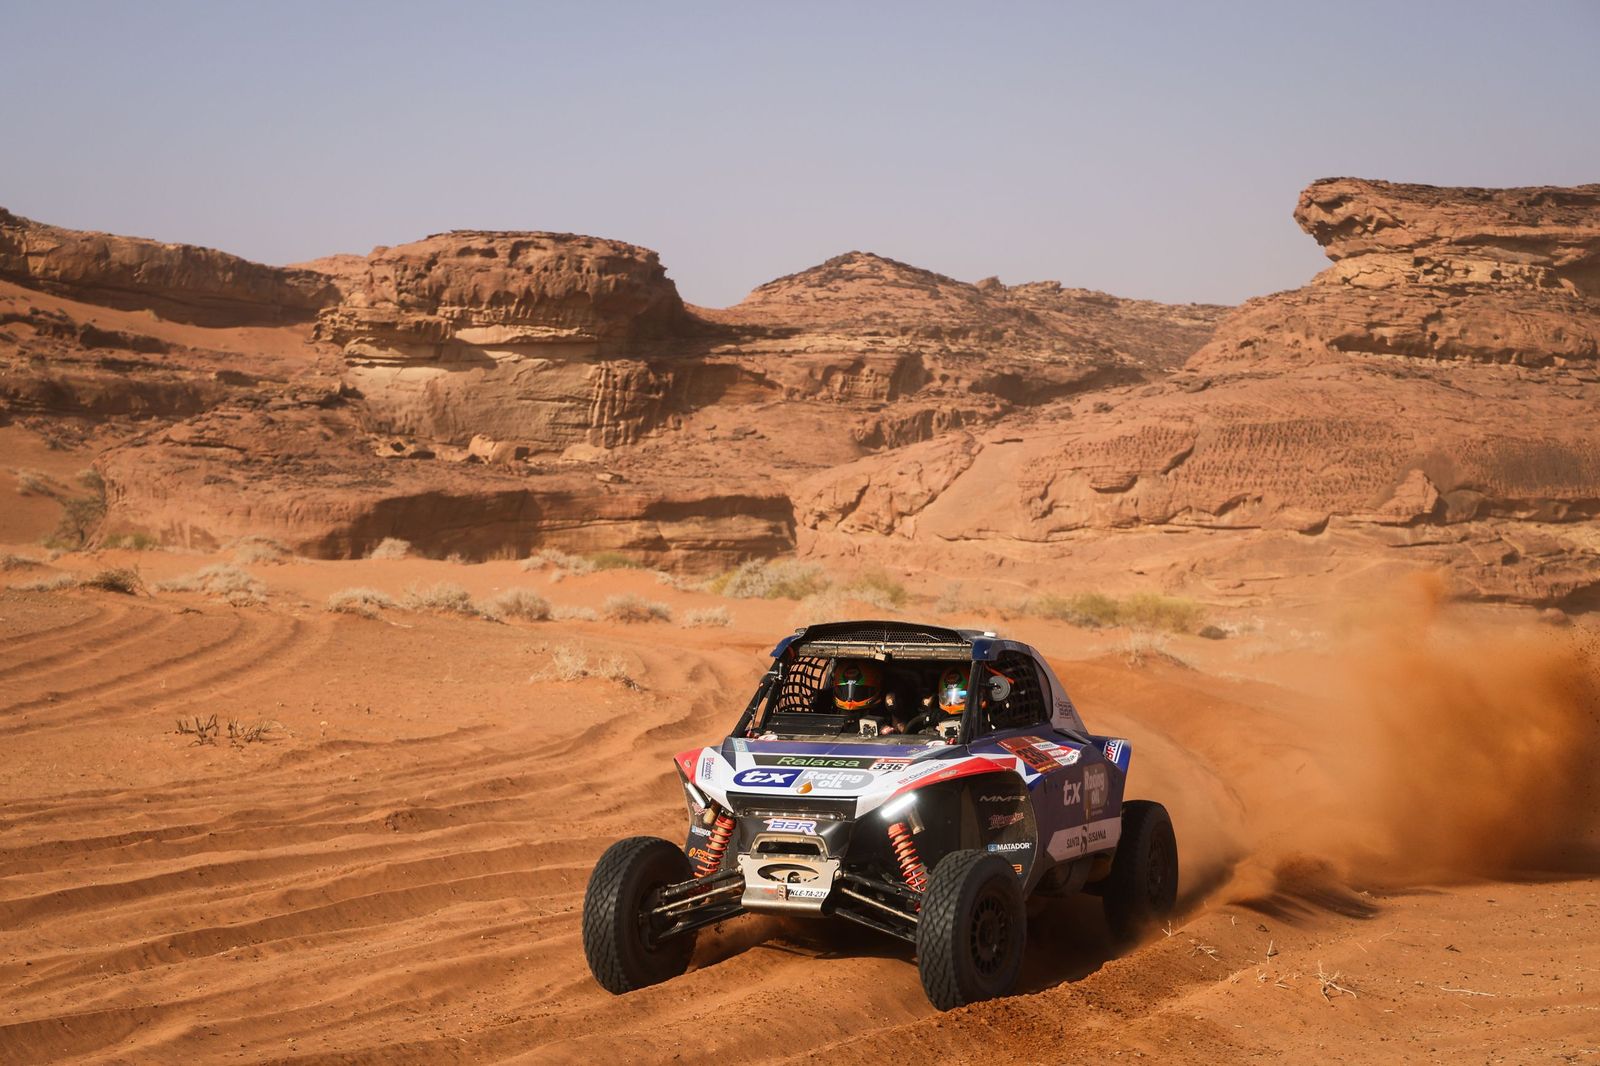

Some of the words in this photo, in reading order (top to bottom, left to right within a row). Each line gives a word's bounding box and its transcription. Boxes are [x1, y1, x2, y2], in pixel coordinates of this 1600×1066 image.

[777, 756, 860, 768] Ralarsa
[873, 763, 904, 771] 336
[741, 769, 795, 784] tx
[803, 770, 865, 784] Racing
[1063, 780, 1081, 806] tx
[1066, 836, 1080, 849] SANTA
[1088, 829, 1107, 843] SUSANNA
[997, 842, 1031, 851] MATADOR
